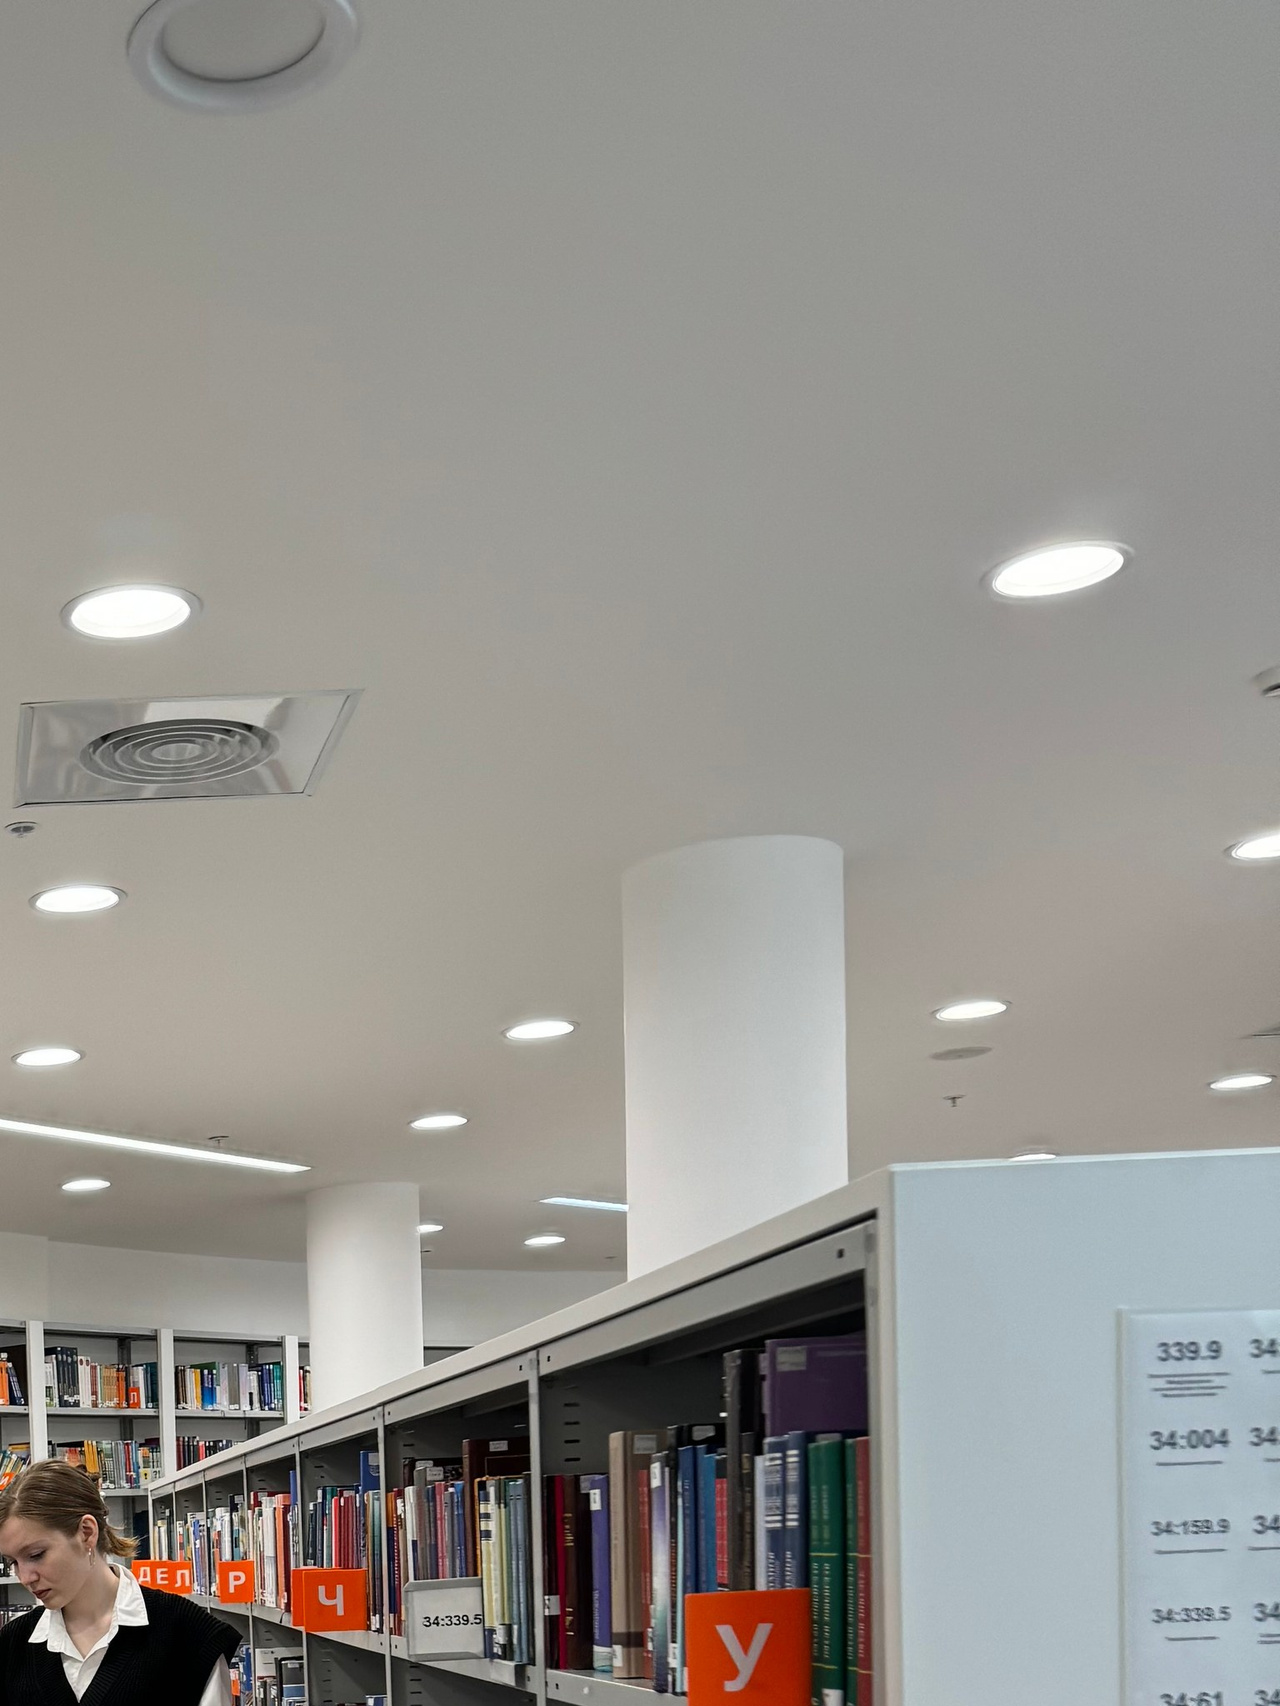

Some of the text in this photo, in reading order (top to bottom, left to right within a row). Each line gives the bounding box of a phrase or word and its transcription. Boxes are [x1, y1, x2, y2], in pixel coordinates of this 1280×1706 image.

[1157, 1340, 1222, 1362] 339.9
[1149, 1429, 1230, 1451] 34:004
[1150, 1518, 1231, 1538] 34:159.9
[138, 1567, 152, 1585] Д
[157, 1569, 169, 1585] Е
[229, 1571, 246, 1592] Р
[317, 1585, 345, 1616] Ч
[422, 1612, 483, 1629] 34:339.5
[715, 1622, 774, 1692] У
